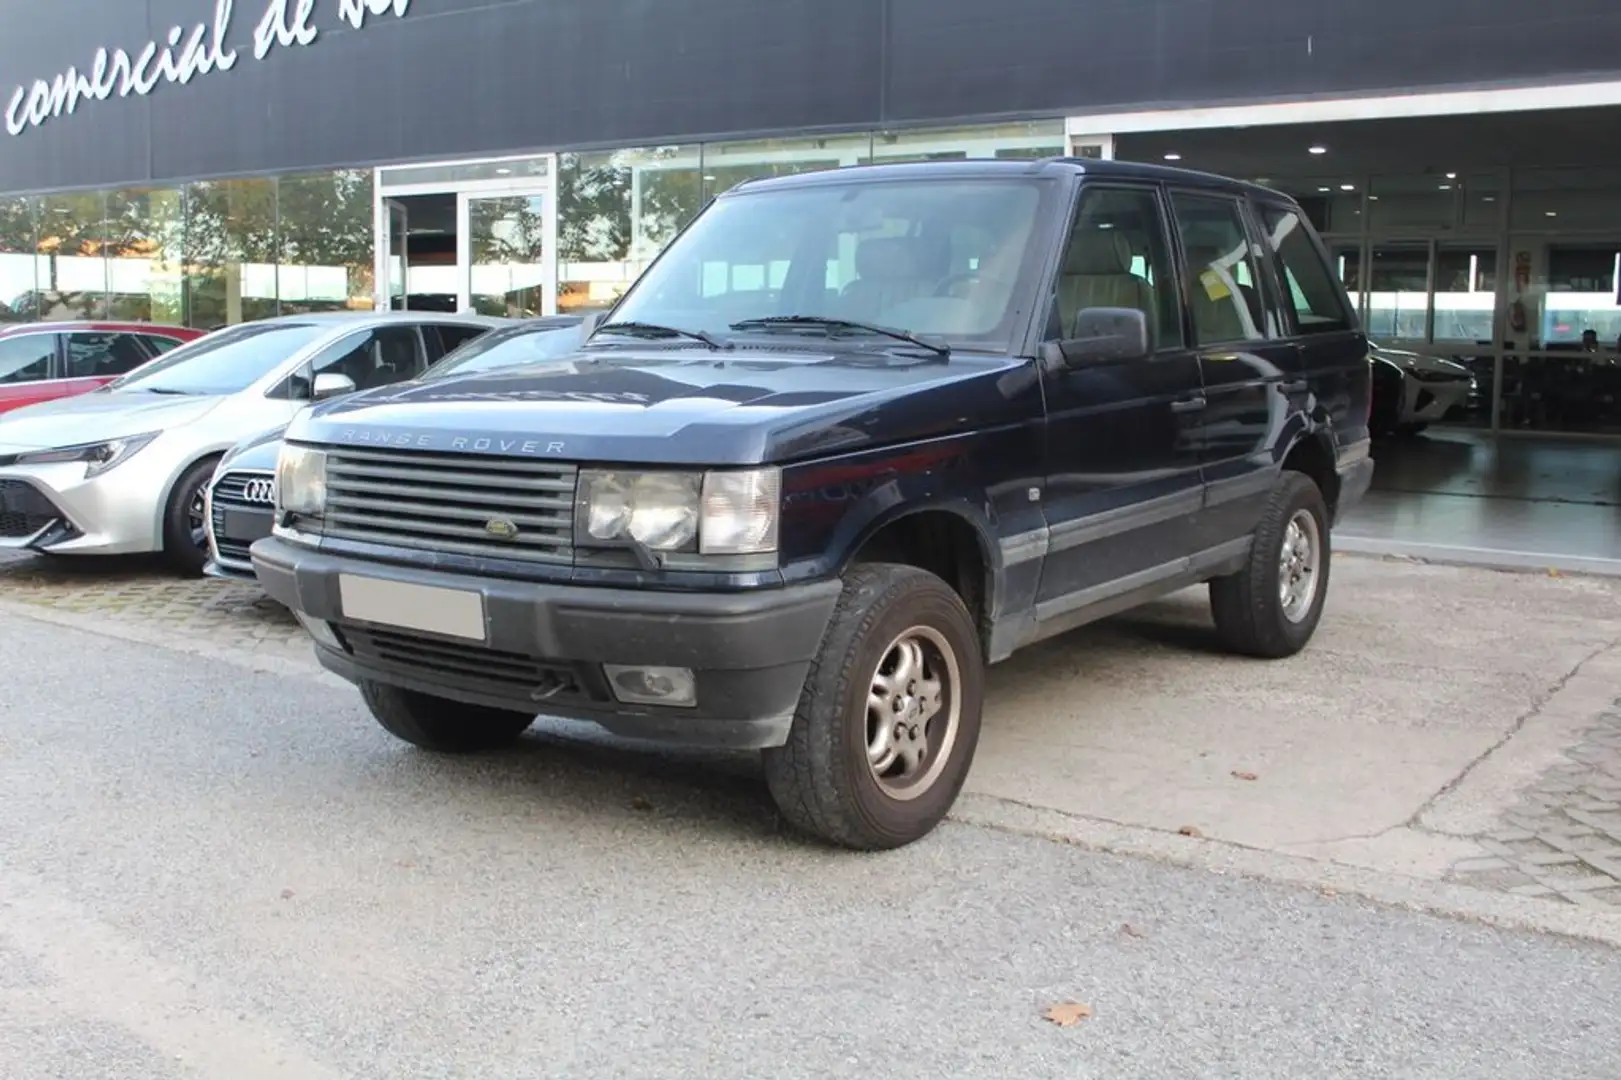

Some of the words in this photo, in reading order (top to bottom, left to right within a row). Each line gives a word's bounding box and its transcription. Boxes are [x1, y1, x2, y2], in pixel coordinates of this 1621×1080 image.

[5, 0, 237, 135] comercial
[253, 0, 317, 60] de
[341, 429, 432, 446] RANGE
[451, 436, 566, 453] ROVER
